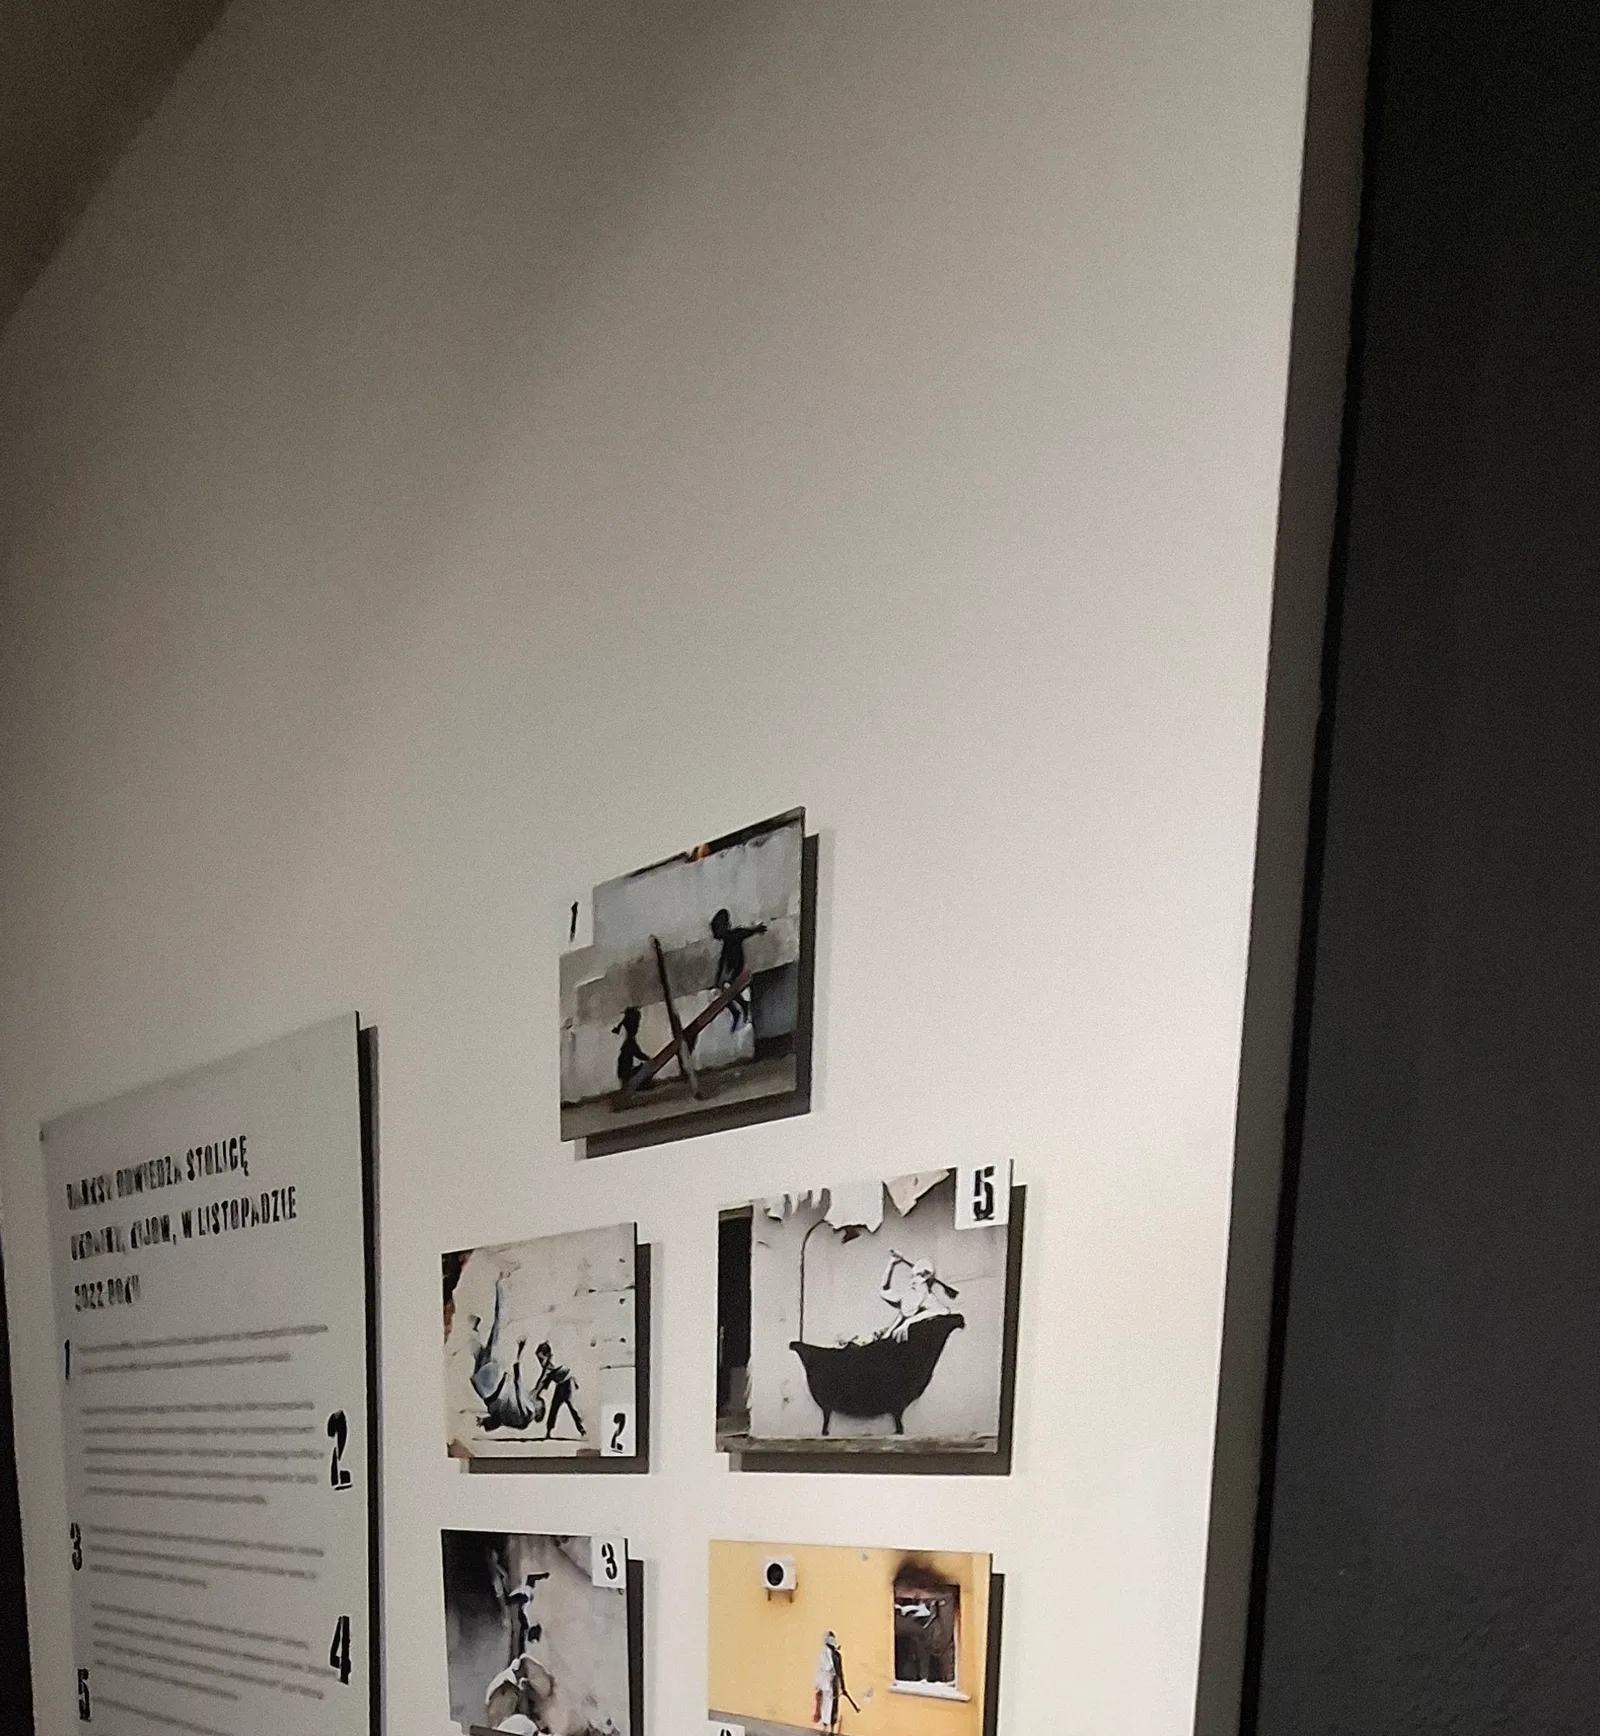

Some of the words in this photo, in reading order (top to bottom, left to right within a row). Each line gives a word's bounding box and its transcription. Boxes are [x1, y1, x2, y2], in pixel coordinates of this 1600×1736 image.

[568, 900, 580, 943] 1
[186, 1135, 250, 1182] STOLICĘ
[181, 1209, 193, 1239] W
[197, 1185, 298, 1236] LISTOPADZIE
[971, 1164, 997, 1223] 5
[63, 1339, 72, 1381] 1
[326, 1409, 354, 1491] 2
[608, 1411, 628, 1453] 2
[69, 1522, 84, 1572] 3
[600, 1542, 620, 1582] 3
[329, 1615, 353, 1685] 4
[76, 1669, 92, 1722] 5
